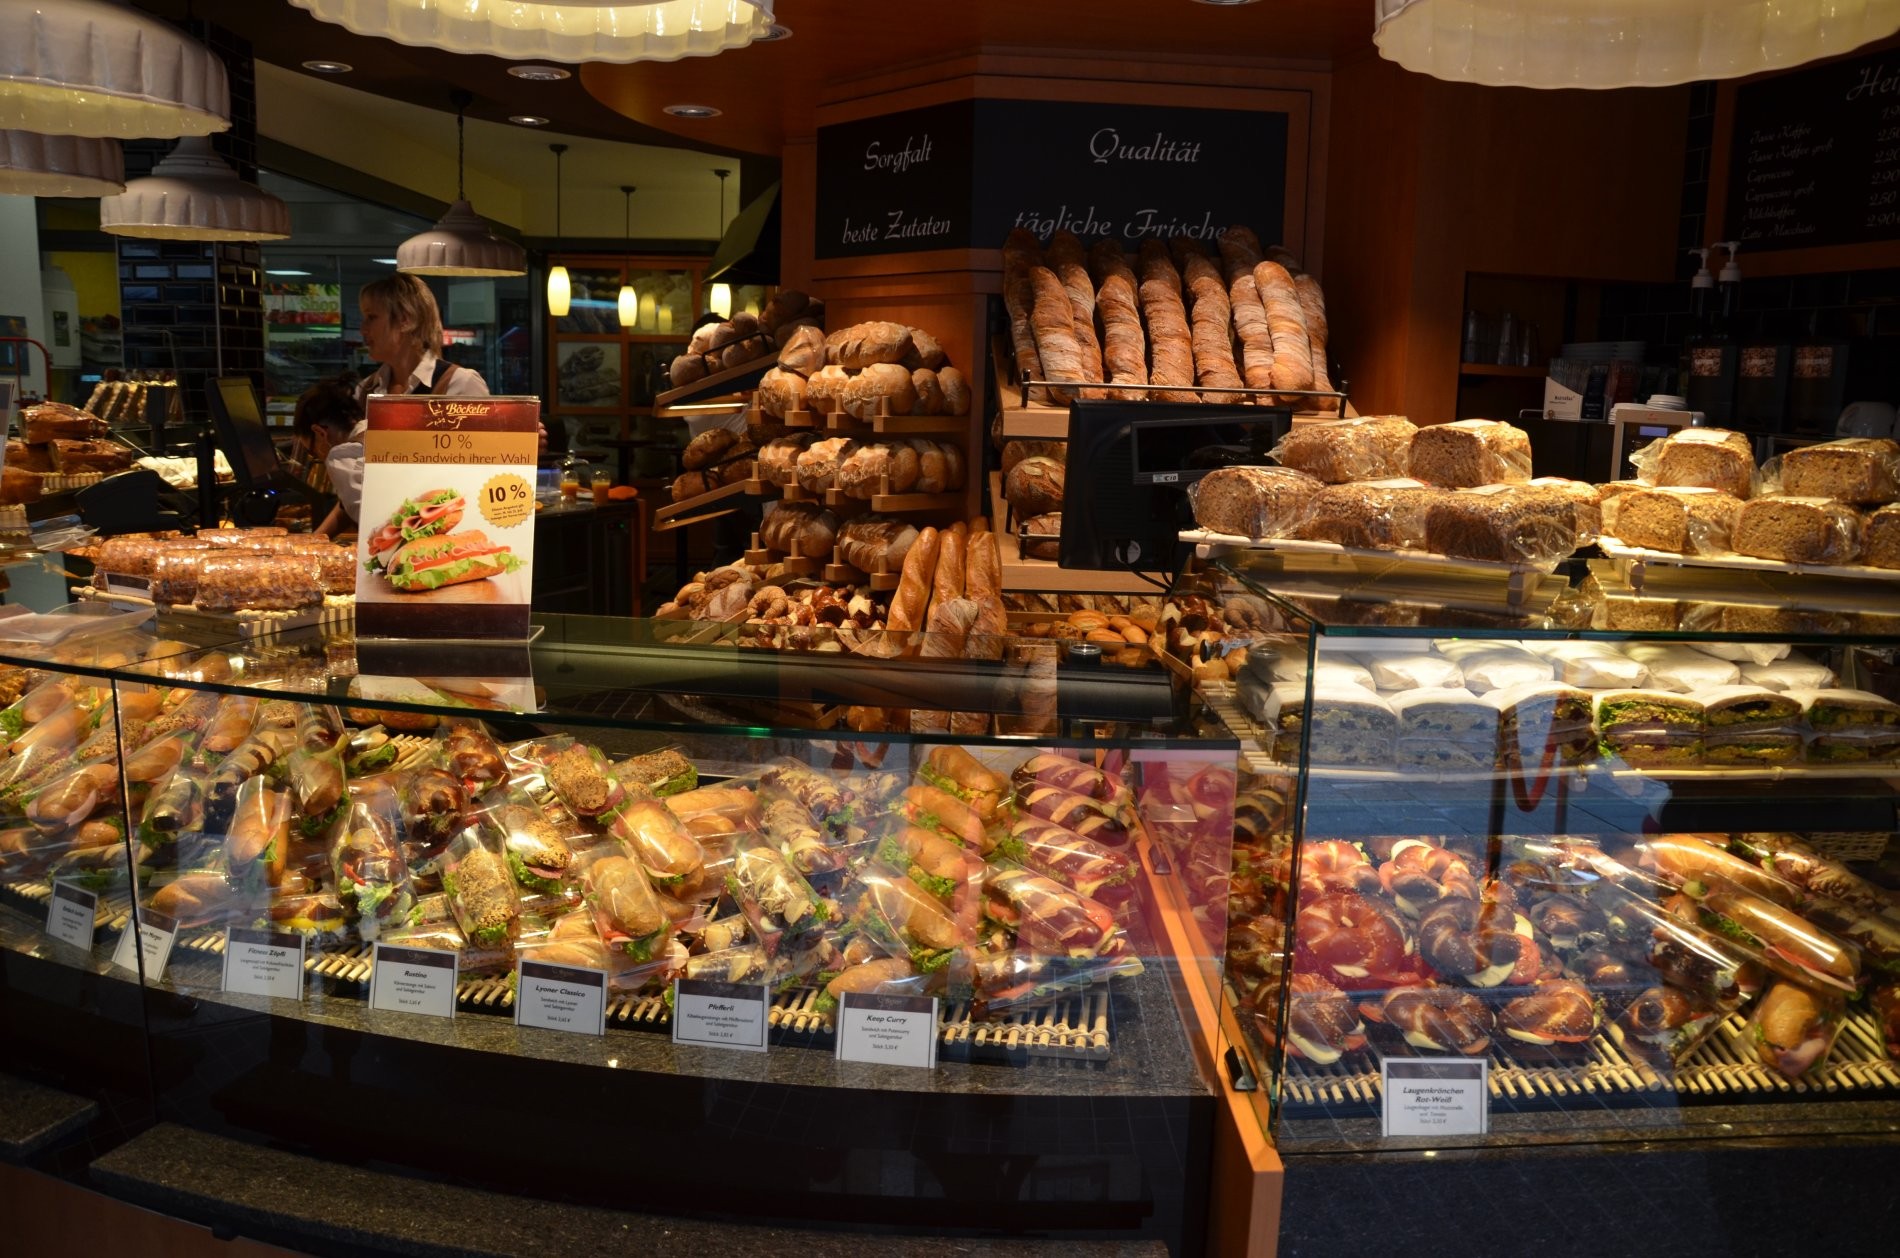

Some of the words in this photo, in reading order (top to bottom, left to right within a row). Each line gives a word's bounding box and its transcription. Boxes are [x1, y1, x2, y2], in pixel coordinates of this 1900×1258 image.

[1846, 64, 1900, 100] Hei
[1777, 123, 1811, 139] Kaffee
[864, 133, 932, 174] Sorgfalt
[1089, 128, 1201, 164] Qualität
[1775, 144, 1809, 159] Kaffee
[1747, 169, 1794, 183] Cappuccino
[1745, 188, 1791, 202] Cappuccino
[842, 217, 879, 244] beste
[884, 210, 951, 240] Zutaten
[1015, 205, 1113, 241] tägliche
[1123, 208, 1229, 241] Frische
[301, 297, 339, 313] Shop
[446, 403, 490, 416] Böckeler
[432, 434, 452, 450] 10
[457, 434, 473, 450] %
[371, 452, 390, 464] auf
[391, 453, 410, 464] ein
[413, 452, 466, 464] Sandwich
[469, 453, 497, 465] ihrer
[501, 453, 531, 465] Wahl
[488, 486, 507, 503] 10
[510, 483, 527, 500] %
[535, 985, 559, 993] Lyoner
[559, 988, 586, 998] Classico
[708, 1003, 735, 1013] Pfefferli
[866, 1015, 886, 1024] Keep
[886, 1016, 908, 1026] Curry
[1403, 1087, 1464, 1096] Laugenkrönchen
[1415, 1095, 1453, 1104] Rot-Weiß
